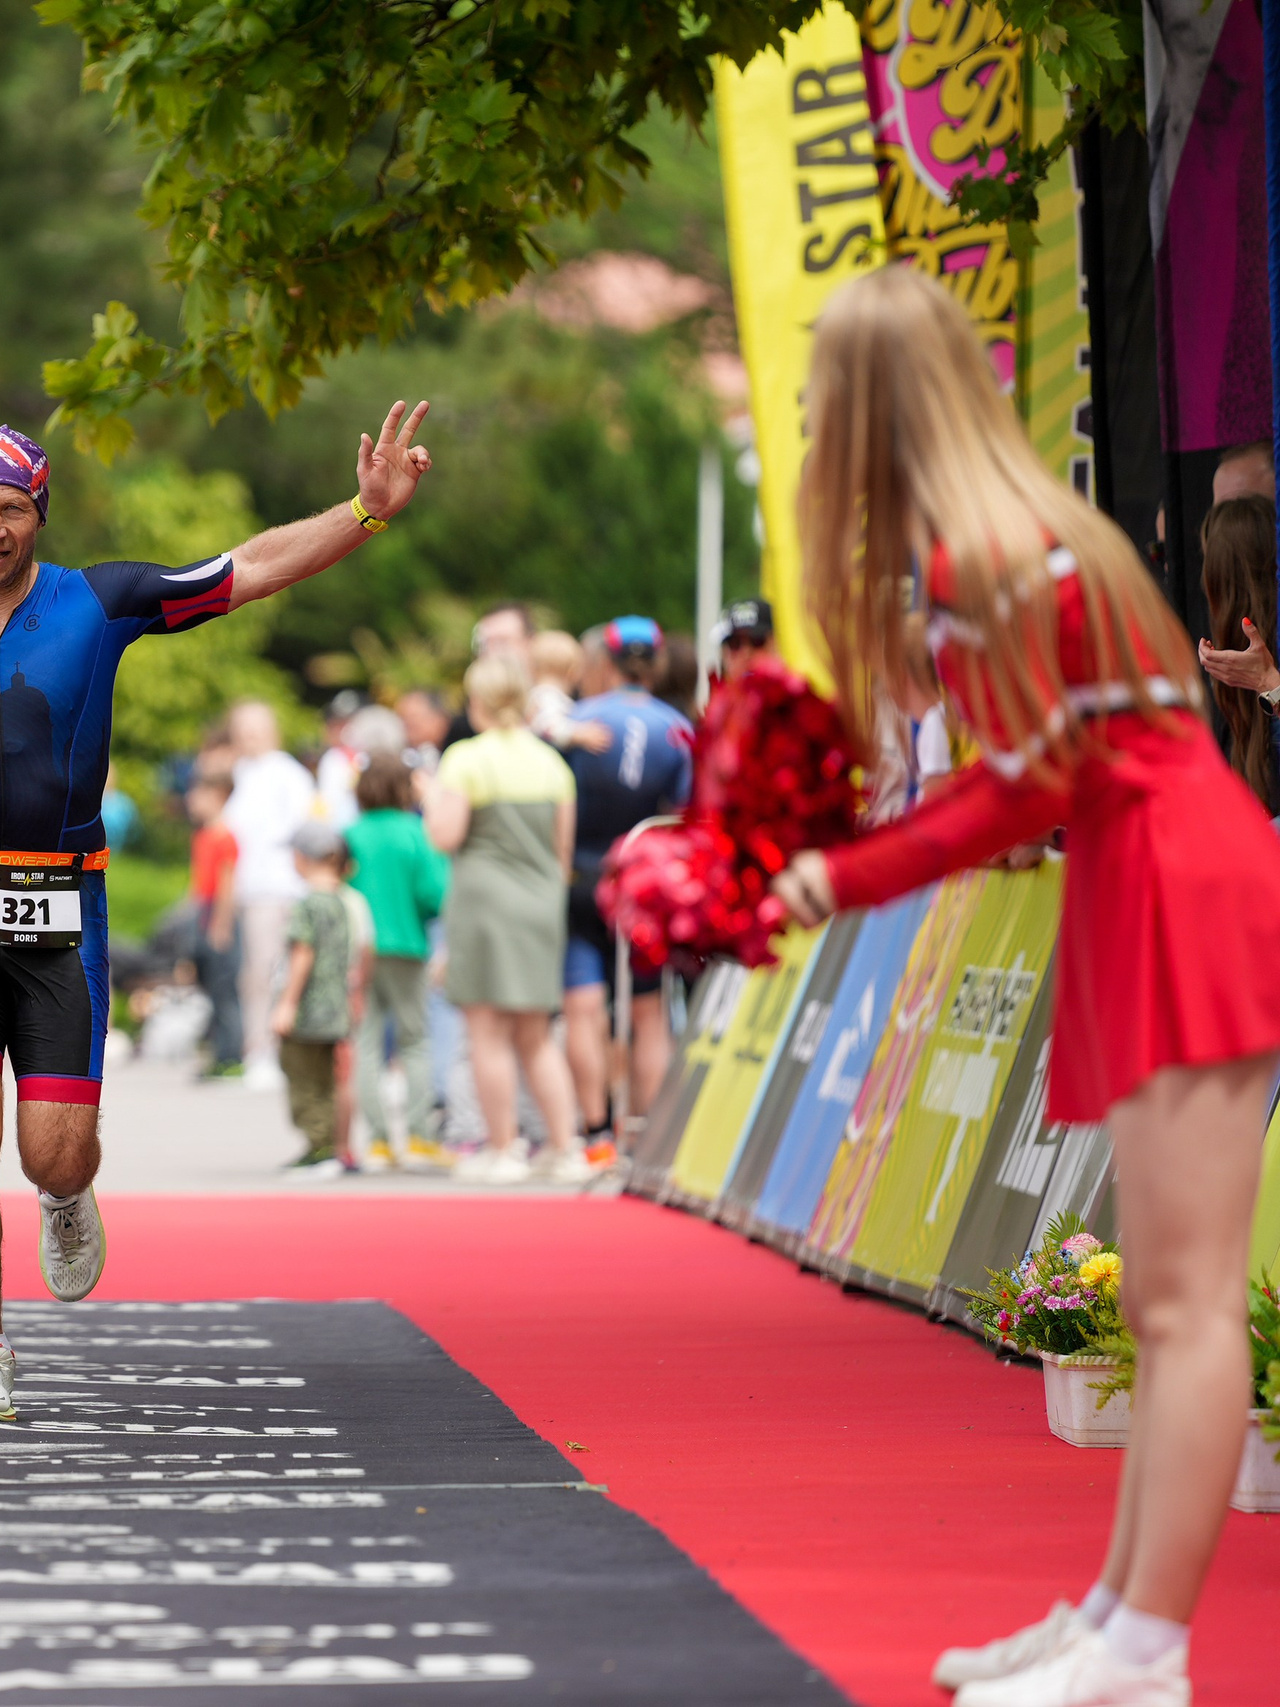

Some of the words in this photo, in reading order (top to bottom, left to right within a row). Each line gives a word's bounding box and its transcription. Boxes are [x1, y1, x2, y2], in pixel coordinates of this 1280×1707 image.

[793, 58, 880, 274] STAR
[30, 872, 45, 880] STAR
[1, 897, 51, 926] 321
[13, 933, 38, 943] BORIS
